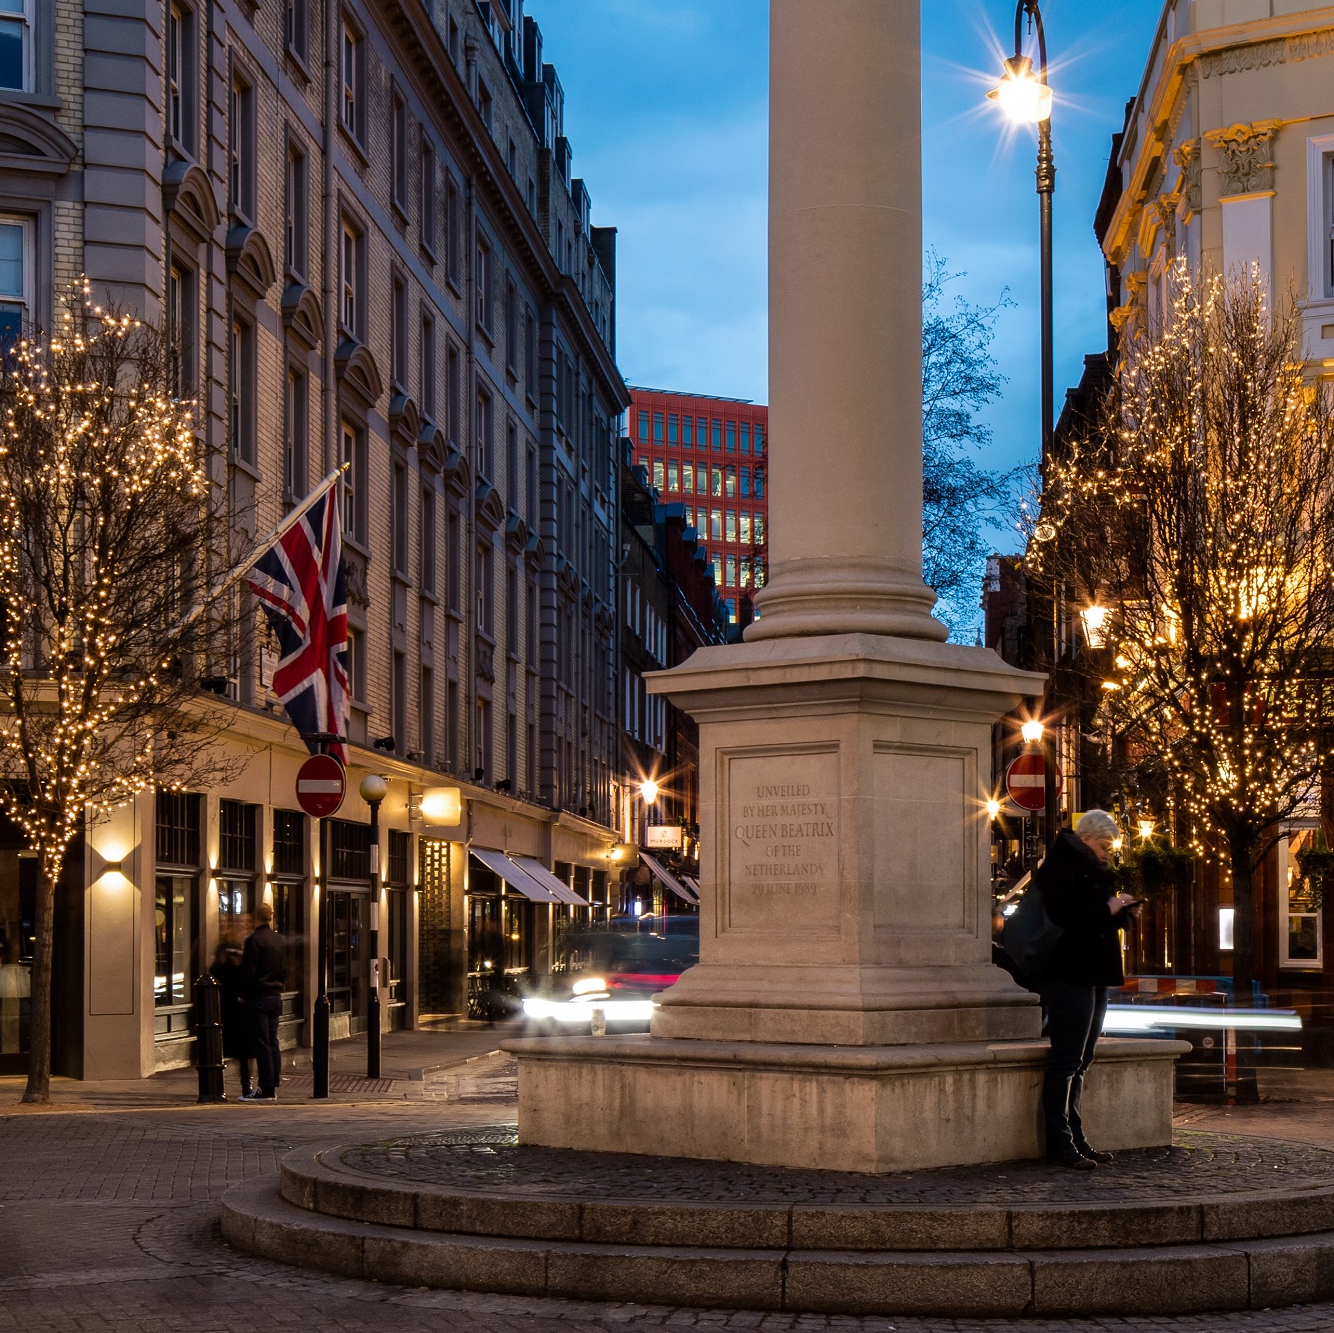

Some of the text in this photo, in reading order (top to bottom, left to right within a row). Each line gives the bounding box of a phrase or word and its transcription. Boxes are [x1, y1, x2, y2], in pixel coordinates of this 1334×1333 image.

[757, 784, 810, 798] UNVEILED
[743, 803, 832, 818] BY HER MAJESTY
[735, 822, 834, 846] QUEEN BEATRIX
[766, 845, 802, 857] OF THE
[745, 863, 824, 876] NETHERLANDS
[752, 883, 817, 896] 29 JUNE 1989
